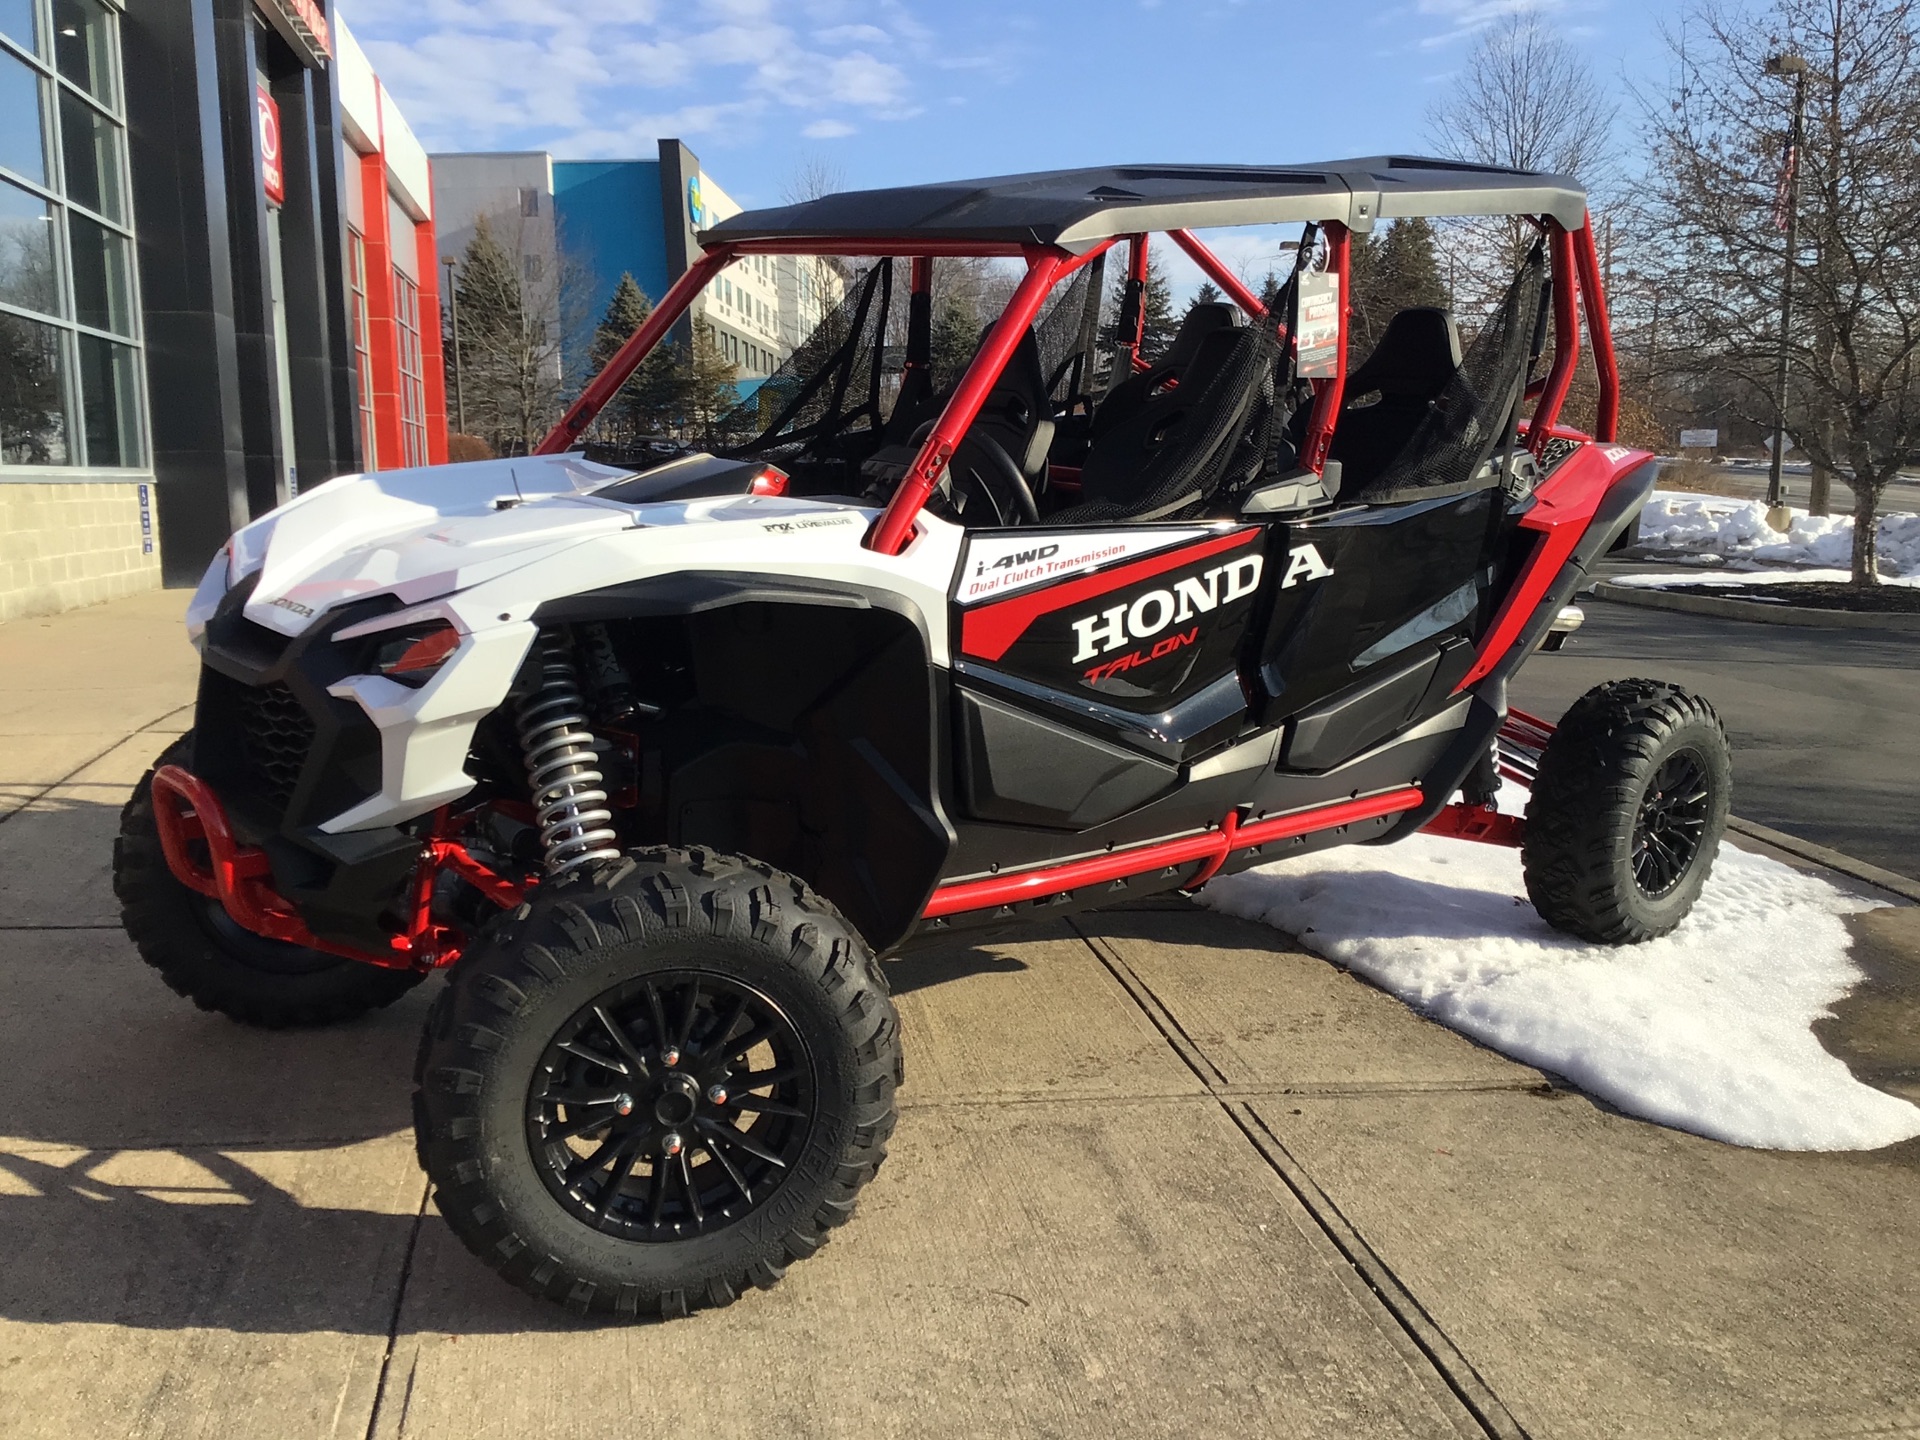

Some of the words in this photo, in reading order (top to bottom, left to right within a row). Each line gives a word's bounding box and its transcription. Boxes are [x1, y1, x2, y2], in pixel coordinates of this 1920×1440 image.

[763, 522, 795, 535] FOX
[969, 578, 999, 595] Dual
[1003, 566, 1043, 585] Clutch
[1046, 545, 1126, 573] Transmission
[976, 544, 1059, 577] i-4WD
[1083, 626, 1199, 687] TALON
